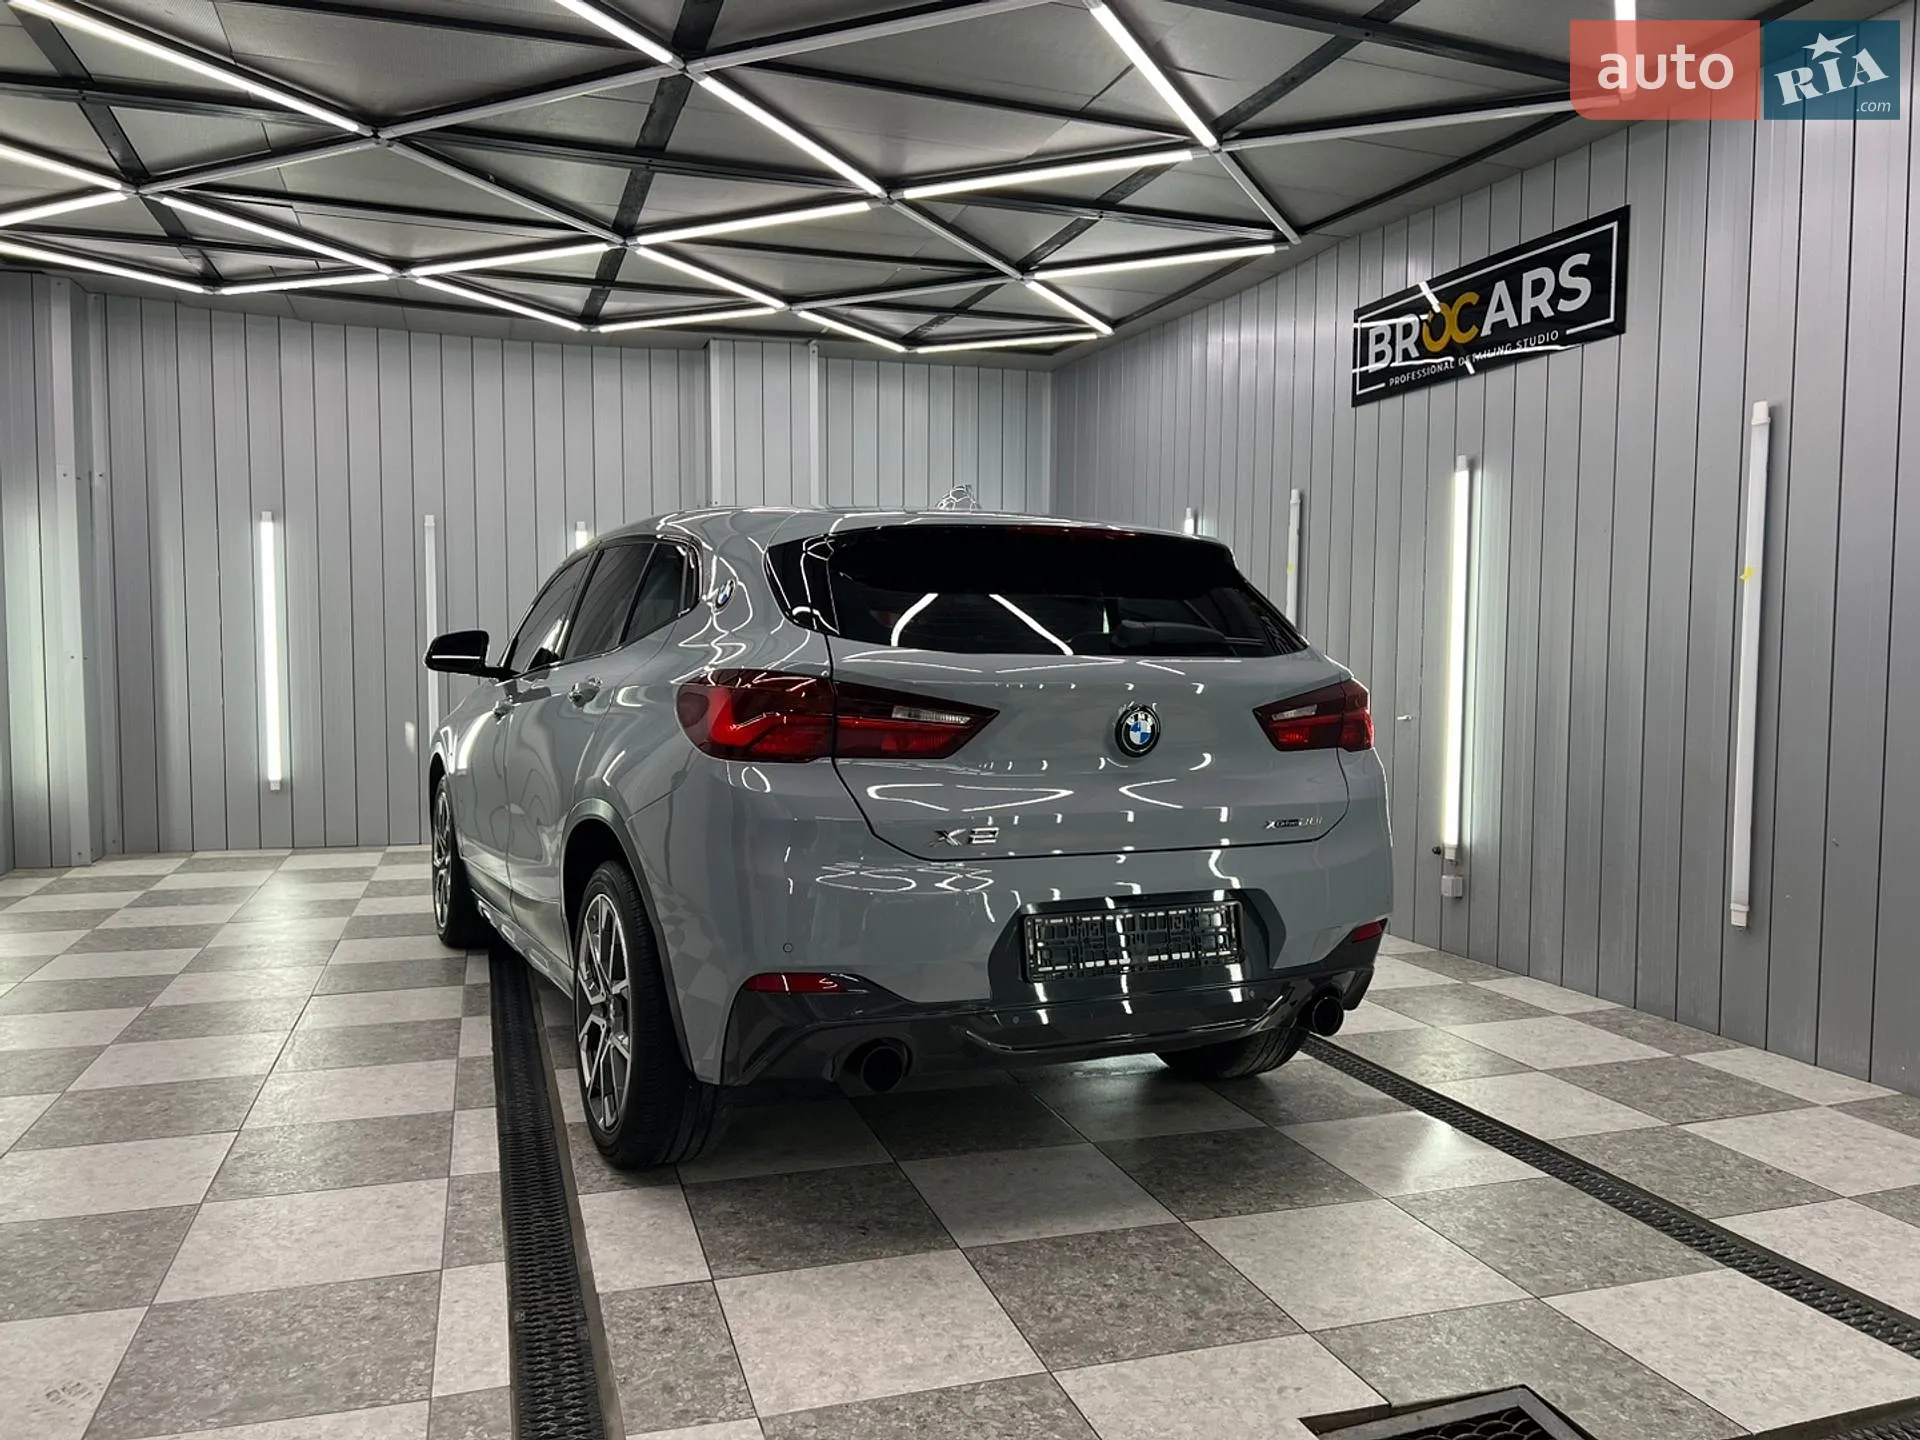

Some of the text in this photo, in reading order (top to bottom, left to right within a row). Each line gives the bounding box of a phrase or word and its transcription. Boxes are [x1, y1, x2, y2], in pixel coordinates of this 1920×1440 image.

[1368, 253, 1592, 373] BROCARS
[1389, 357, 1455, 387] PROFESSIONAL
[1515, 329, 1559, 350] STUDIO
